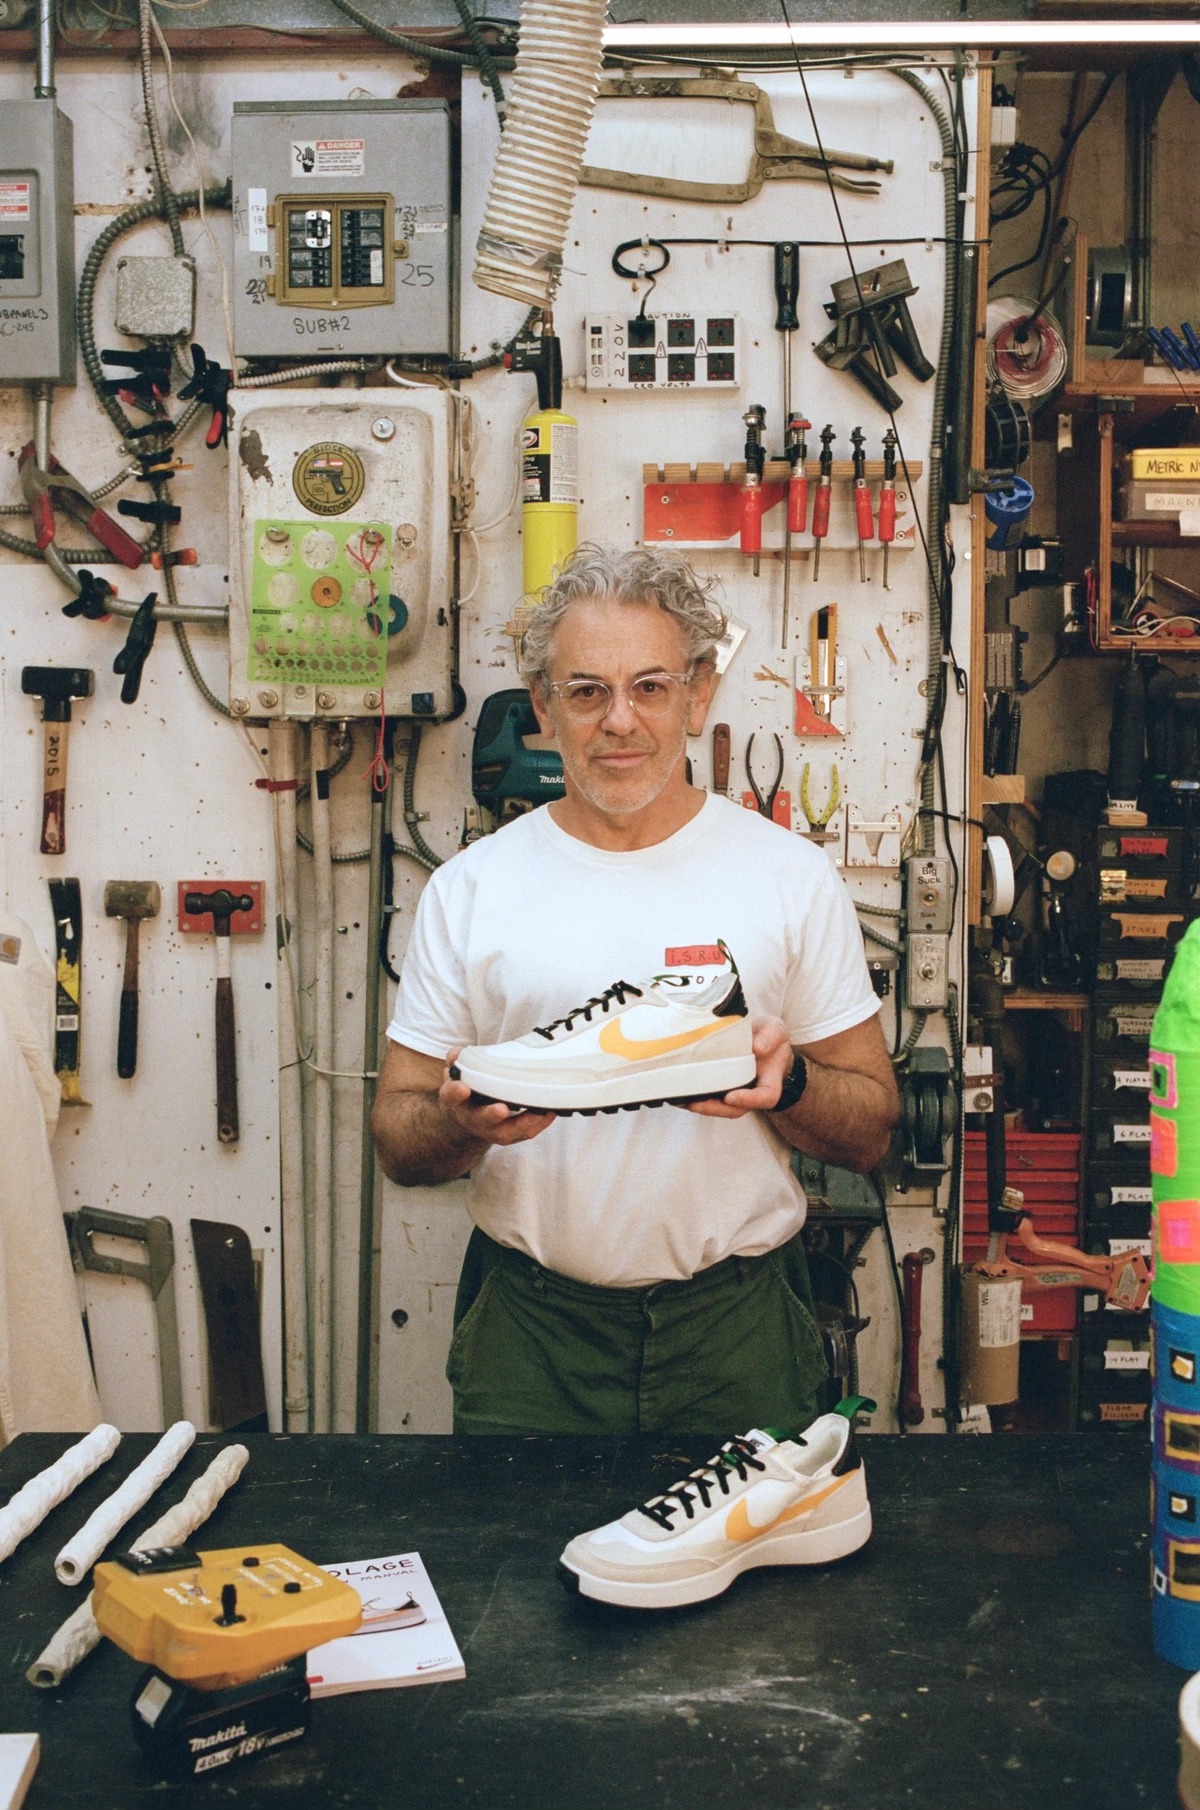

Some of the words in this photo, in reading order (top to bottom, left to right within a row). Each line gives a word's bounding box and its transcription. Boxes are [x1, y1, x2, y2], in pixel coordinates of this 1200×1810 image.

[259, 255, 272, 269] 19
[401, 263, 435, 286] 25
[245, 279, 267, 294] 20
[293, 315, 351, 334] SUB#2
[304, 497, 352, 513] PERFECTION
[47, 736, 60, 776] 2015
[921, 866, 937, 876] Big
[917, 876, 941, 884] Suck
